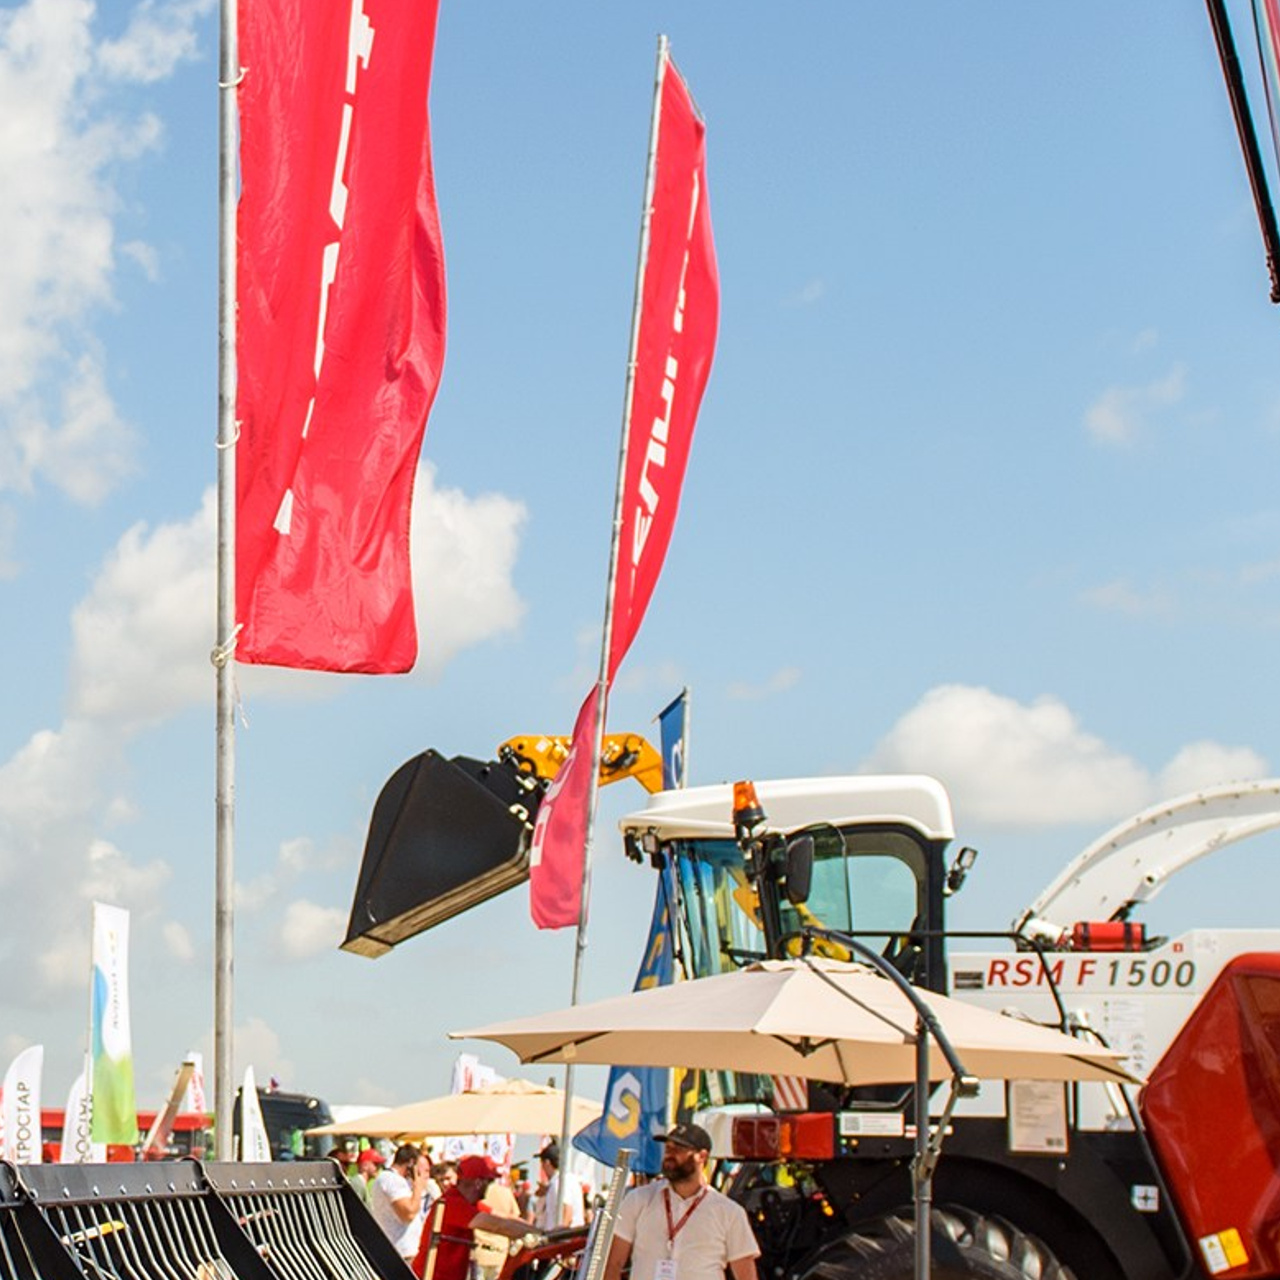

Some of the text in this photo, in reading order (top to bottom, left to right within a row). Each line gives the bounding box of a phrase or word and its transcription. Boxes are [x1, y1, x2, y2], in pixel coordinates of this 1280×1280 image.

[987, 959, 1196, 988] RSM F 1500
